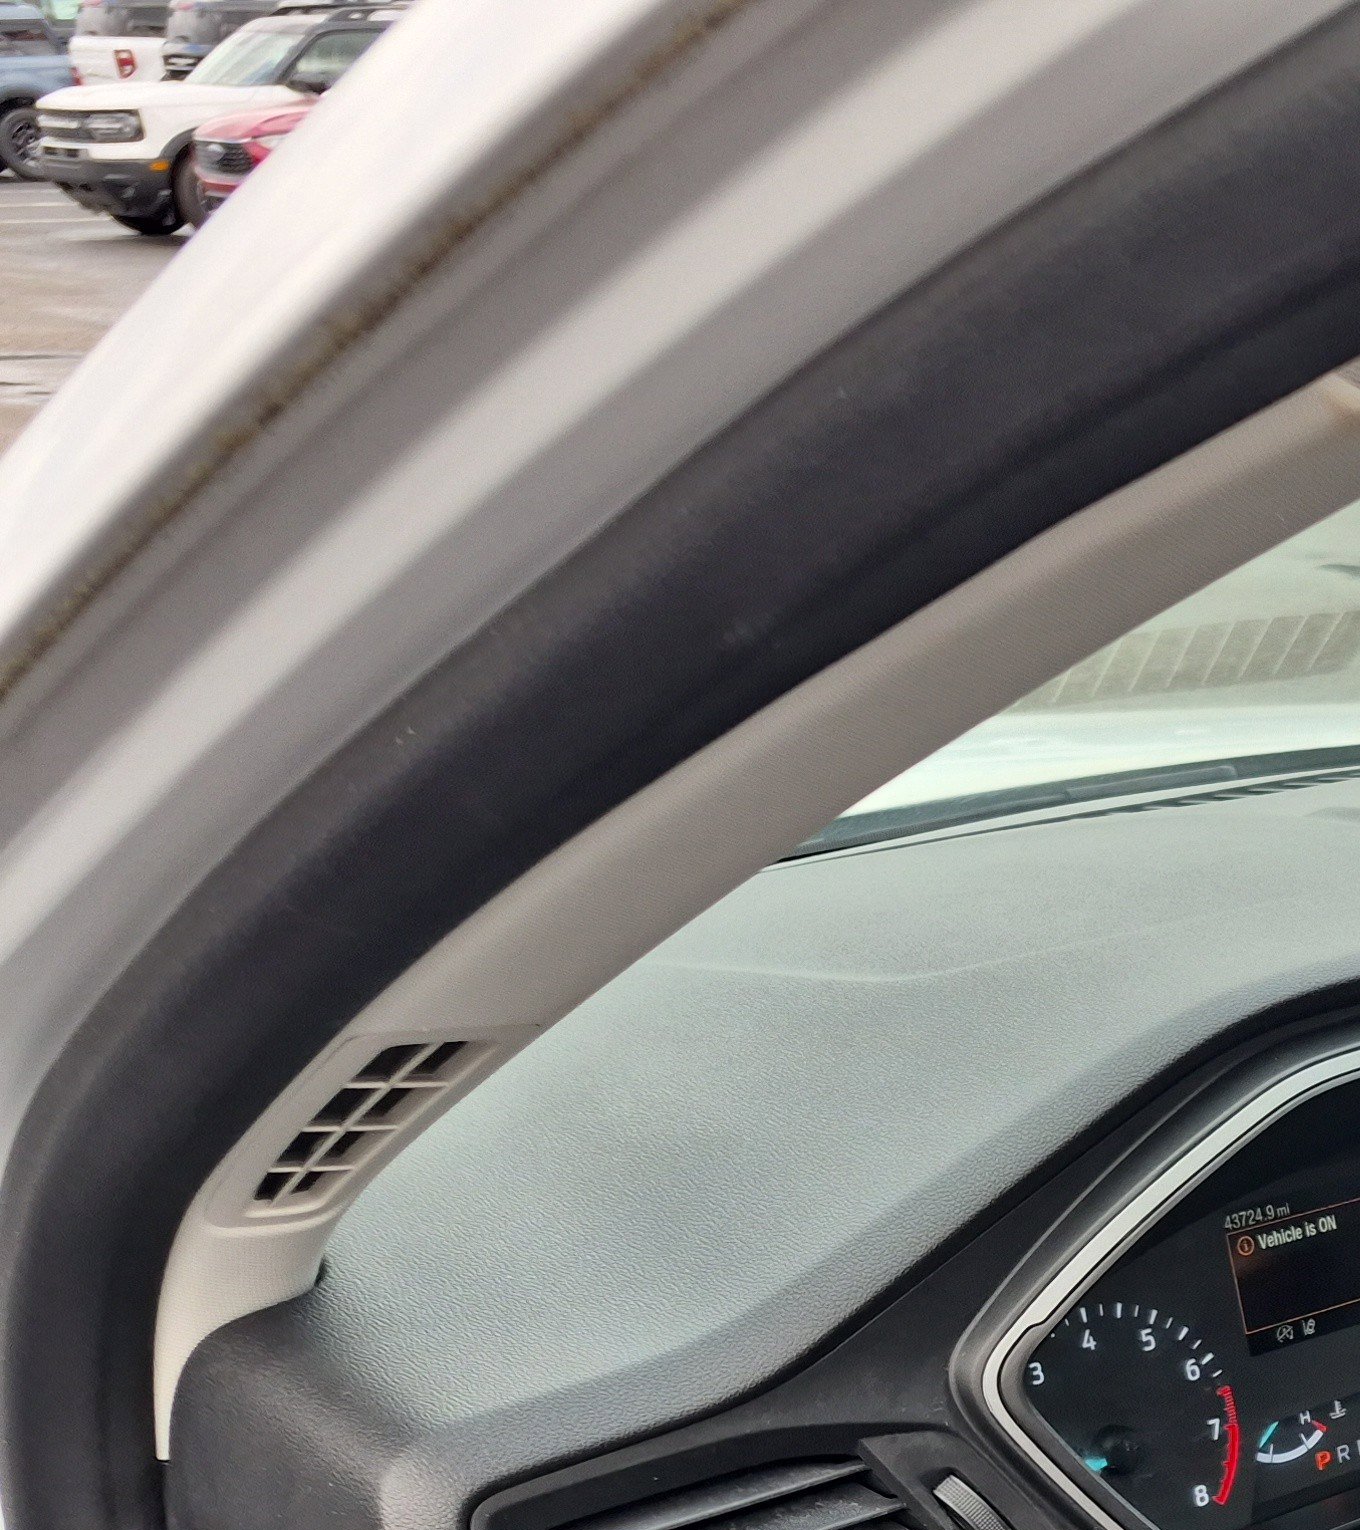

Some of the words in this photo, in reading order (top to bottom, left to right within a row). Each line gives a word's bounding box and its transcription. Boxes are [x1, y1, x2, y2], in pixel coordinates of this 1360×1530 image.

[1223, 1204, 1276, 1231] 43724.9
[1256, 1224, 1303, 1251] Vehicle
[1305, 1220, 1317, 1237] is
[1318, 1214, 1338, 1233] ON
[1081, 1329, 1098, 1351] 4
[1139, 1328, 1157, 1352] 5
[1027, 1361, 1045, 1385] 3
[1184, 1358, 1201, 1382] 6
[1206, 1418, 1221, 1441] 7
[1299, 1410, 1312, 1425] H
[1314, 1450, 1333, 1471] P
[1336, 1444, 1351, 1464] R
[1192, 1484, 1210, 1507] 8
